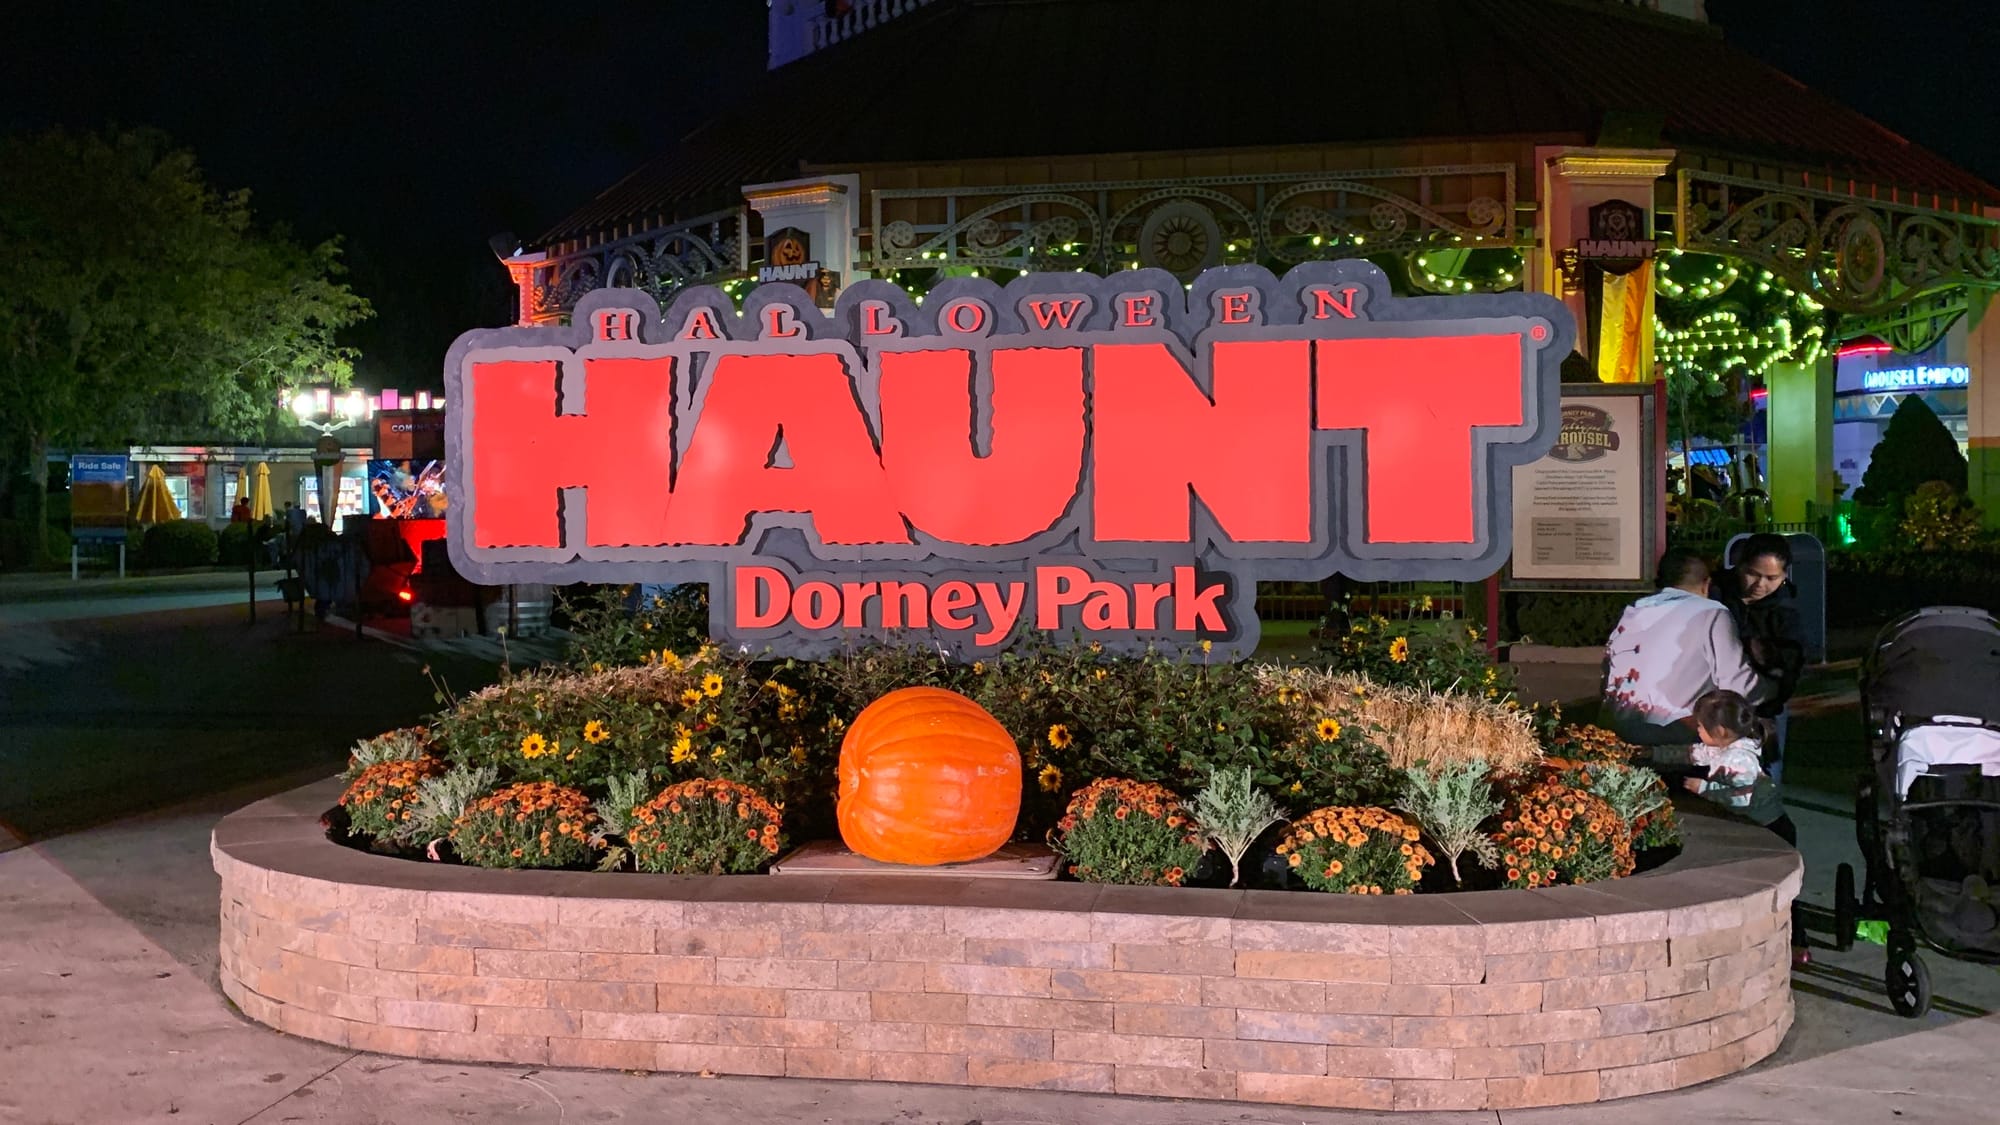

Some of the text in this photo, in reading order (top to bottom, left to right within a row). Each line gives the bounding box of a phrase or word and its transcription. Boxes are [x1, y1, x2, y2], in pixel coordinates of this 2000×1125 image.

[1580, 239, 1656, 257] HAUNT
[760, 262, 819, 282] HAUNT
[598, 286, 1358, 342] HALLOWEEN
[471, 332, 1524, 549] HAUNT
[1558, 430, 1612, 448] ROUSEL
[78, 462, 121, 470] Ride Safe
[735, 565, 1228, 647] Dorney Park
